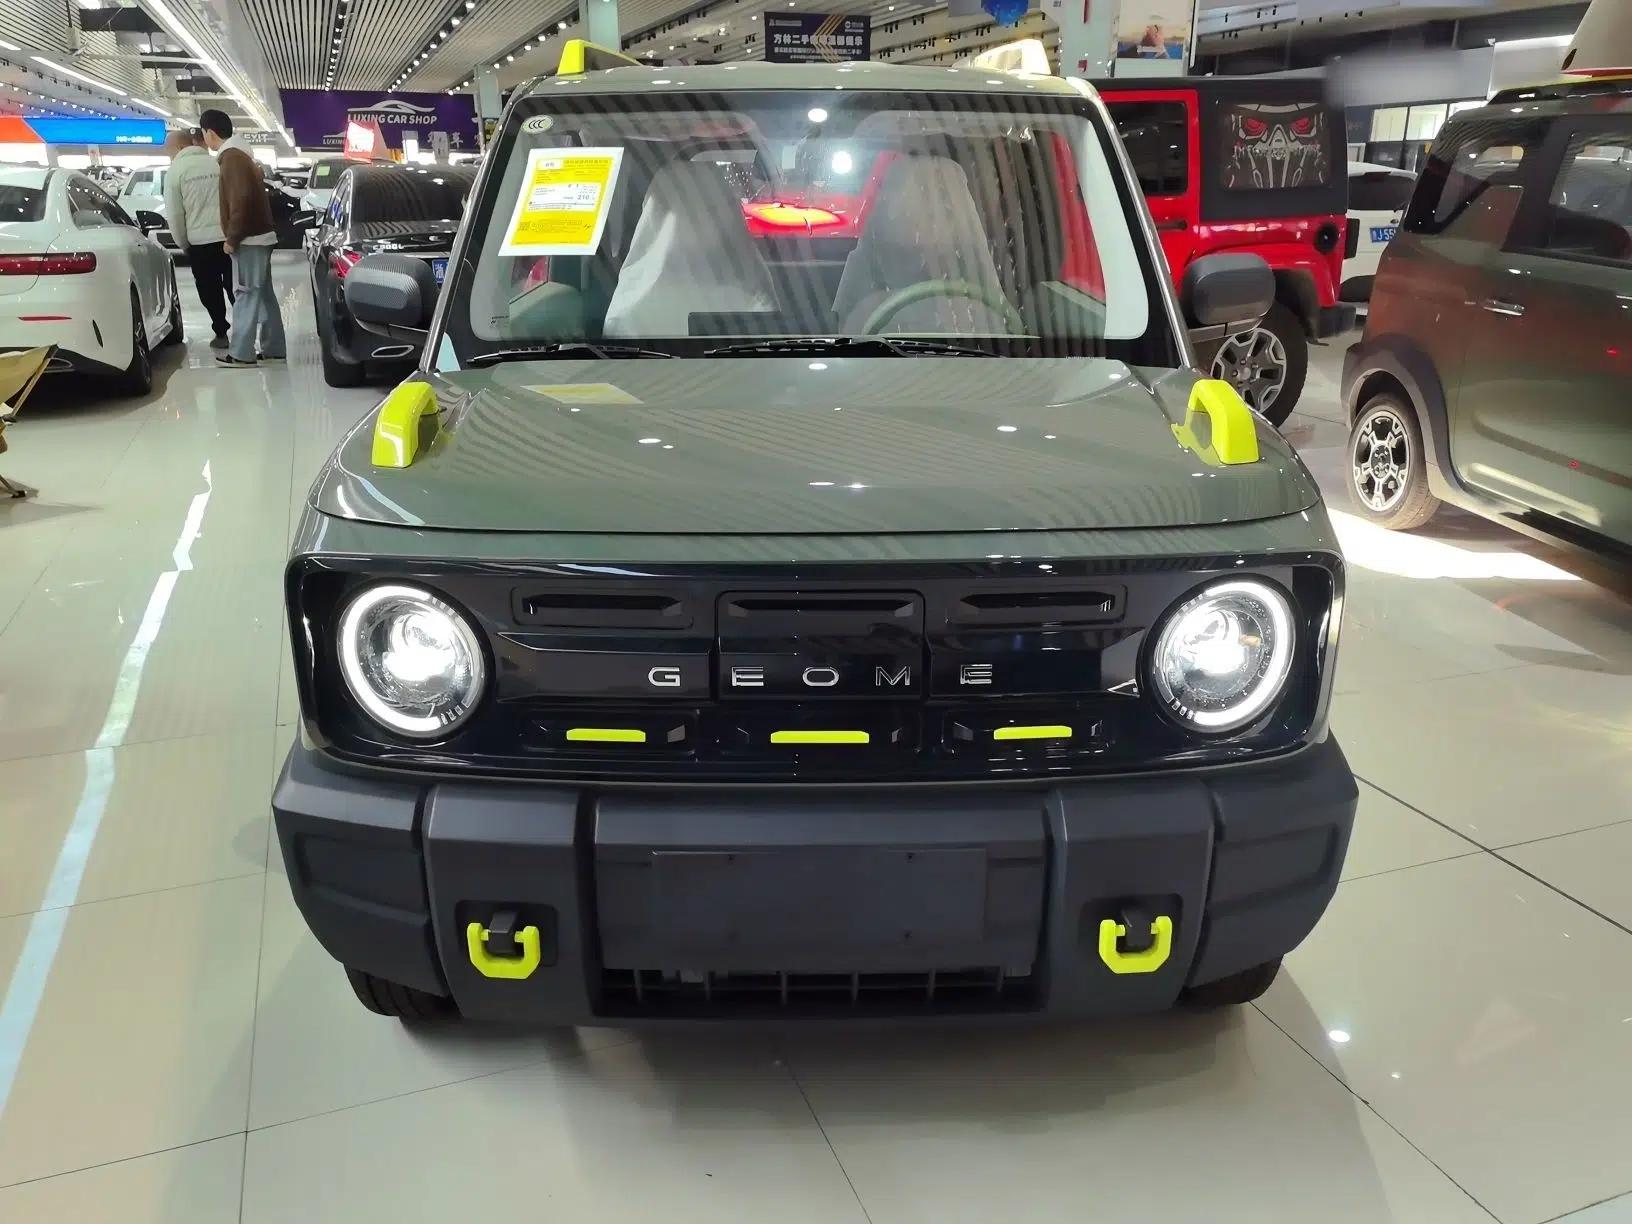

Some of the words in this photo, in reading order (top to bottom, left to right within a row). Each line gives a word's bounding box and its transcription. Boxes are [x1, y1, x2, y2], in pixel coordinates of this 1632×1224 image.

[348, 113, 385, 123] LUXING
[387, 114, 407, 123] CAR
[408, 114, 437, 124] SHOP
[648, 663, 993, 687] GEOME
